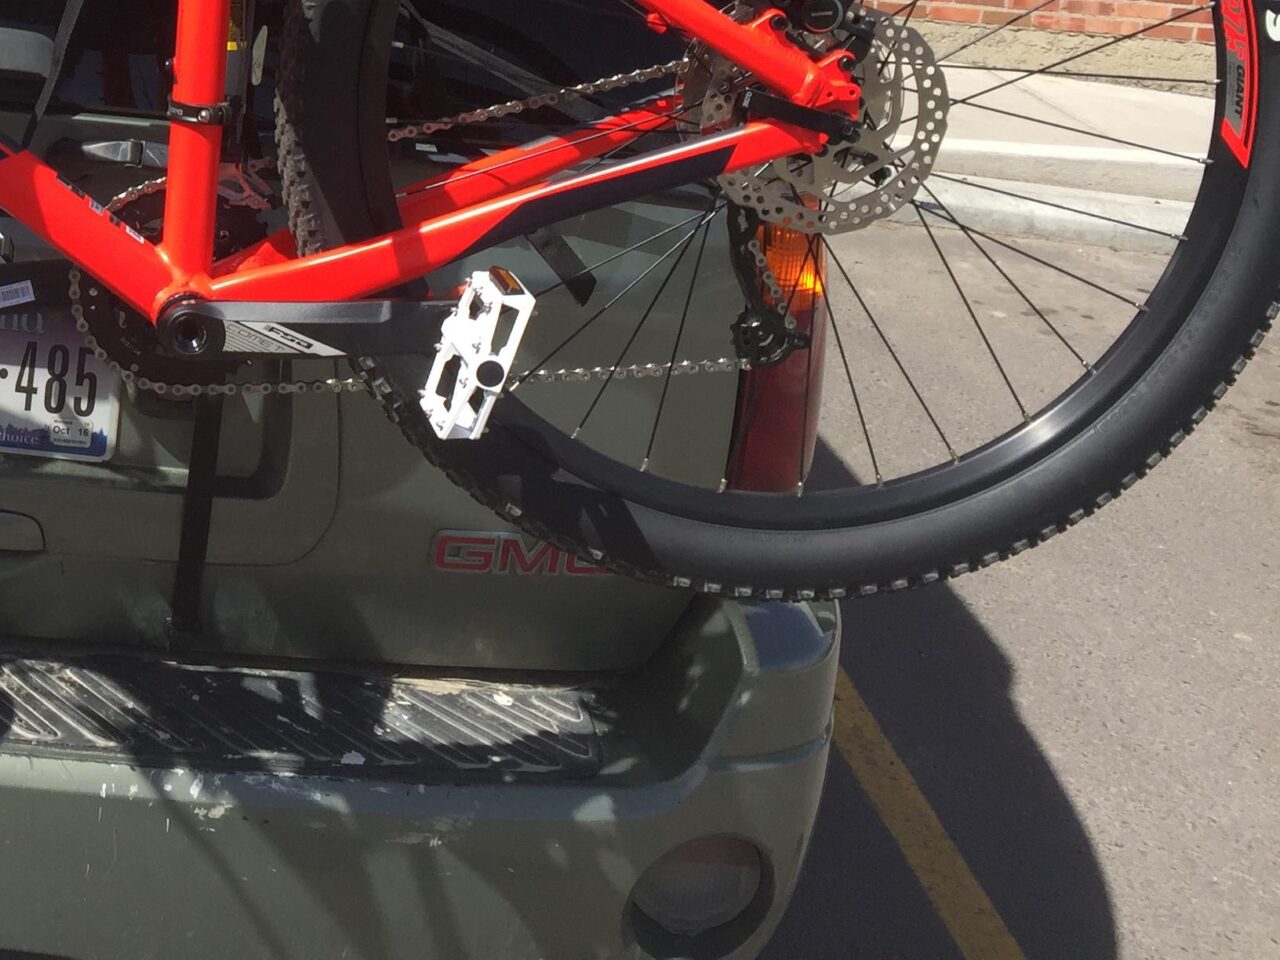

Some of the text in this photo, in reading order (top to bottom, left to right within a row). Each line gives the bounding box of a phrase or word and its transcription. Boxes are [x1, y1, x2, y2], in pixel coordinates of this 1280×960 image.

[1234, 64, 1246, 120] GIANT
[226, 322, 285, 351] COMET
[53, 425, 70, 435] Oct
[434, 535, 613, 574] GMC
